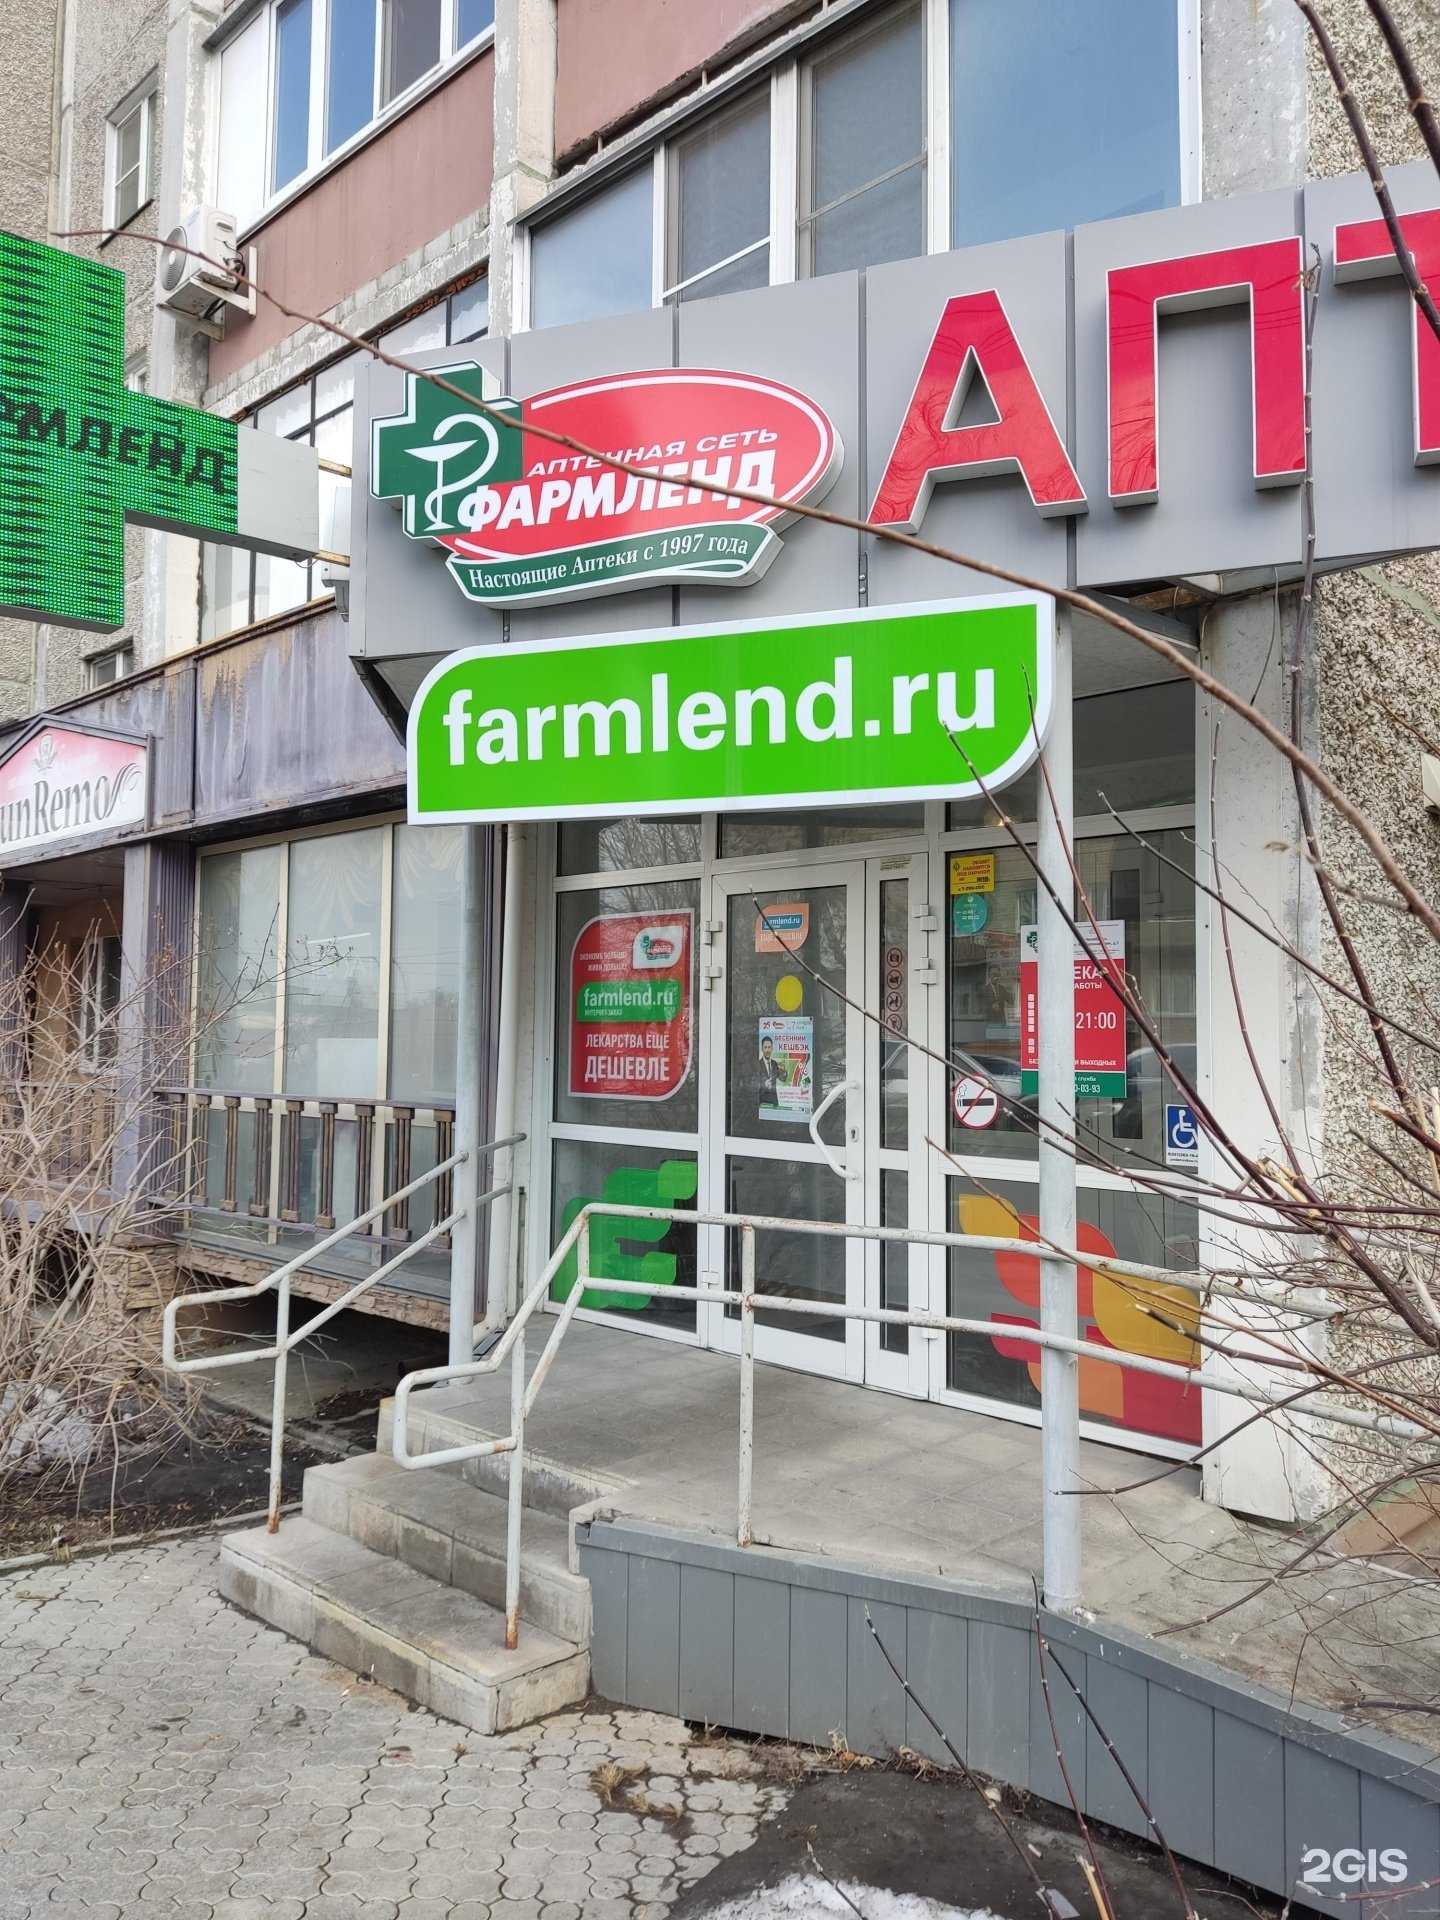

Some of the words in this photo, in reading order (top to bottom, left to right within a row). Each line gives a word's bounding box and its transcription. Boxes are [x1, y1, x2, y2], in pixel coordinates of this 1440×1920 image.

[527, 440, 687, 478] АПТЕЧНАЯ
[696, 428, 779, 451] СЕТЬ
[457, 449, 776, 533] ФАРМЛЕНД
[468, 564, 567, 589] Настоящие
[572, 551, 638, 576] Аптеки
[643, 545, 654, 561] с
[659, 534, 705, 558] 1997
[708, 536, 749, 555] года
[443, 655, 996, 766] farmlend.ru
[1074, 966, 1103, 980] ЕКА
[584, 987, 673, 1007] farmlend.ru
[1074, 982, 1102, 990] АБОТЫ
[1075, 1012, 1117, 1030] 21:00
[585, 1033, 643, 1048] ЛЕКАРСТВА
[584, 1056, 670, 1083] ДЕШЕВЛЕ
